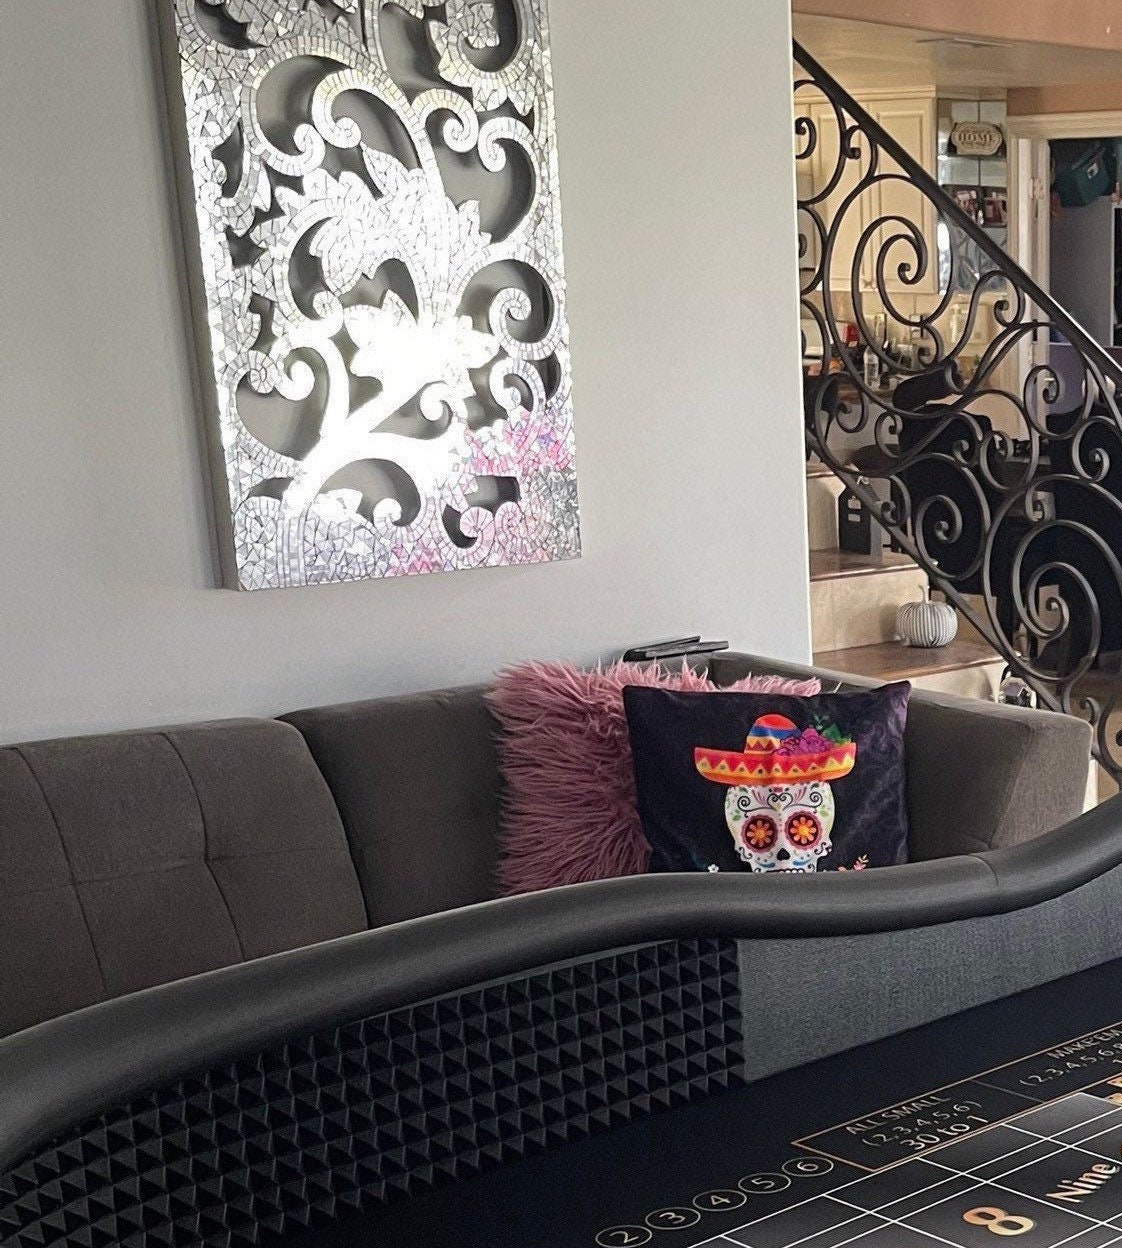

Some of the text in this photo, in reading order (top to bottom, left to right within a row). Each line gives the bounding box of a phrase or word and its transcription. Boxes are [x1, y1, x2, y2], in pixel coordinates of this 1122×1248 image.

[845, 1095, 950, 1135] ALL SMALL
[900, 1115, 988, 1150] 30 to 1
[1045, 1161, 1120, 1203] Nine
[962, 1205, 1037, 1236] 8
